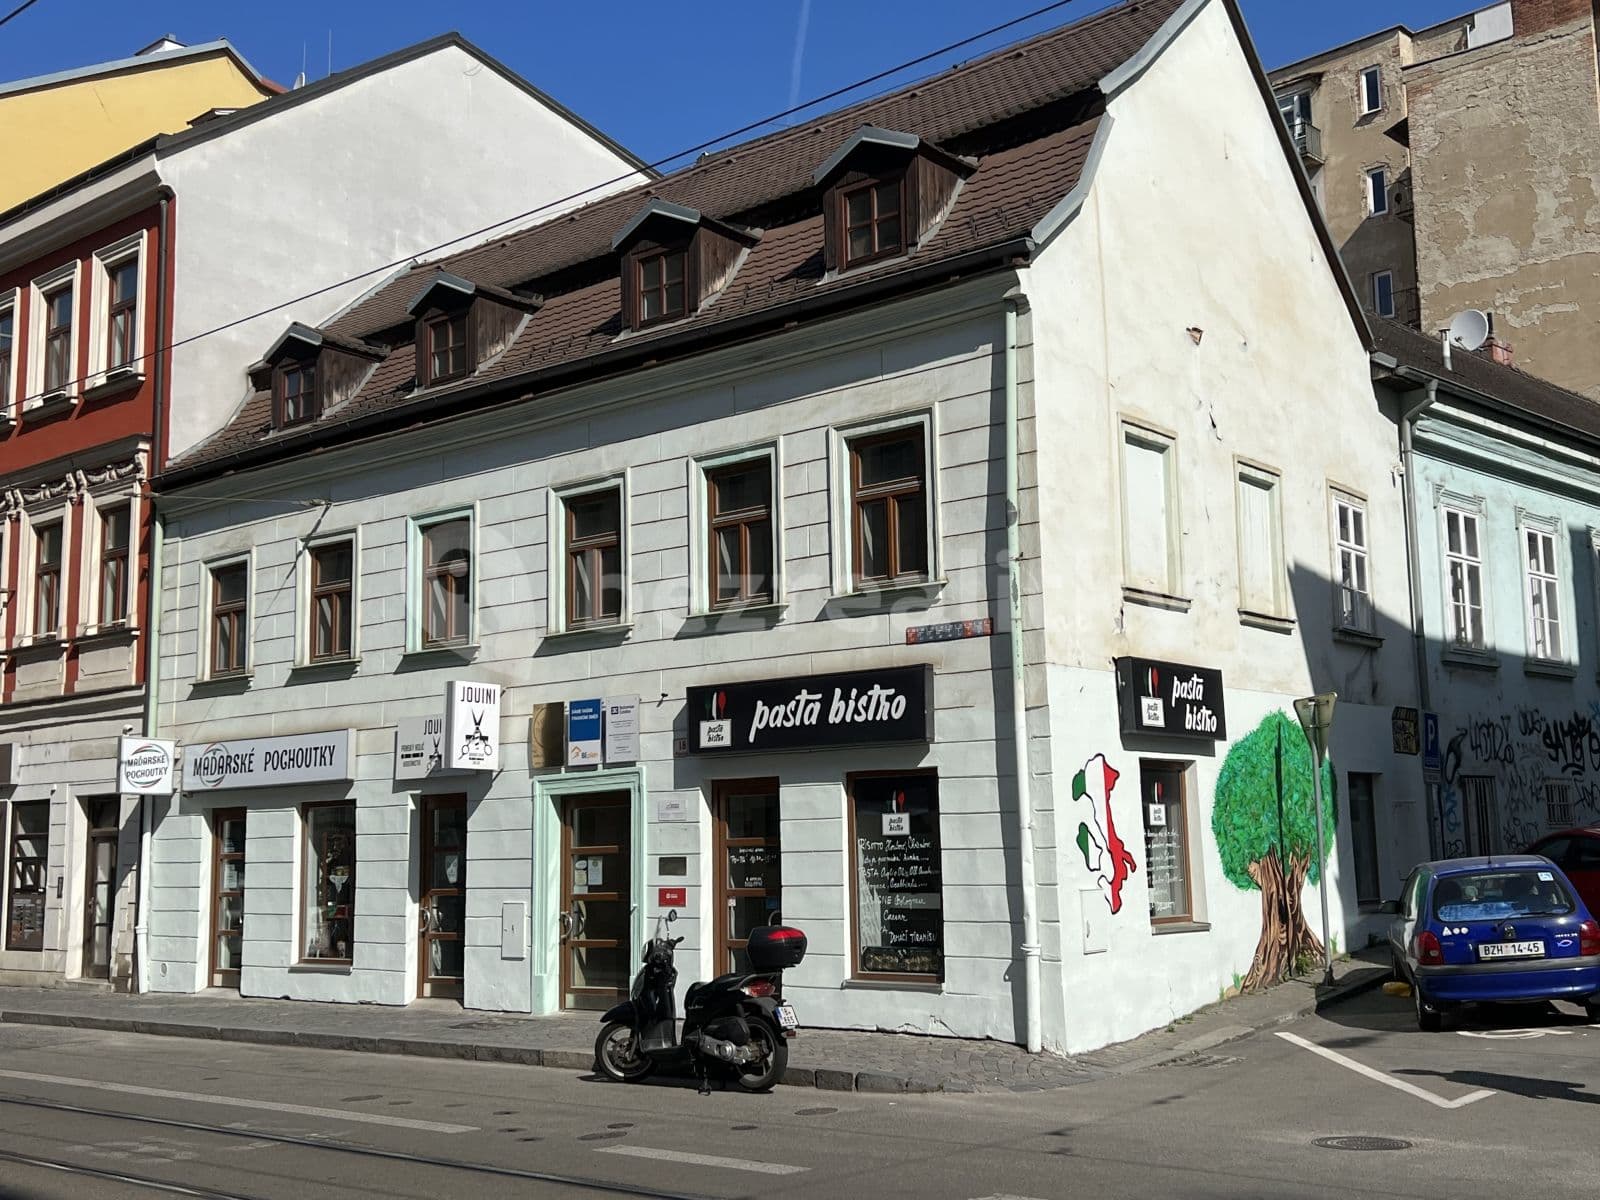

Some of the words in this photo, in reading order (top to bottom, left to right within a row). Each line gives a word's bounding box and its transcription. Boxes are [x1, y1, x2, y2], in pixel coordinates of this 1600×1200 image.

[460, 686, 496, 705] JOUINI
[1171, 672, 1204, 708] pasta
[748, 688, 822, 744] pasta
[828, 684, 906, 724] bistro
[1185, 703, 1217, 733] bistro
[707, 724, 723, 735] pasta
[707, 733, 724, 743] bistro
[1427, 719, 1435, 751] P
[126, 767, 168, 779] POCHOUTKY
[193, 747, 254, 777] MAĎARSKÉ
[264, 745, 336, 772] POCHOUTKY
[1484, 945, 1503, 955] BZH
[1511, 943, 1540, 953] 14-45
